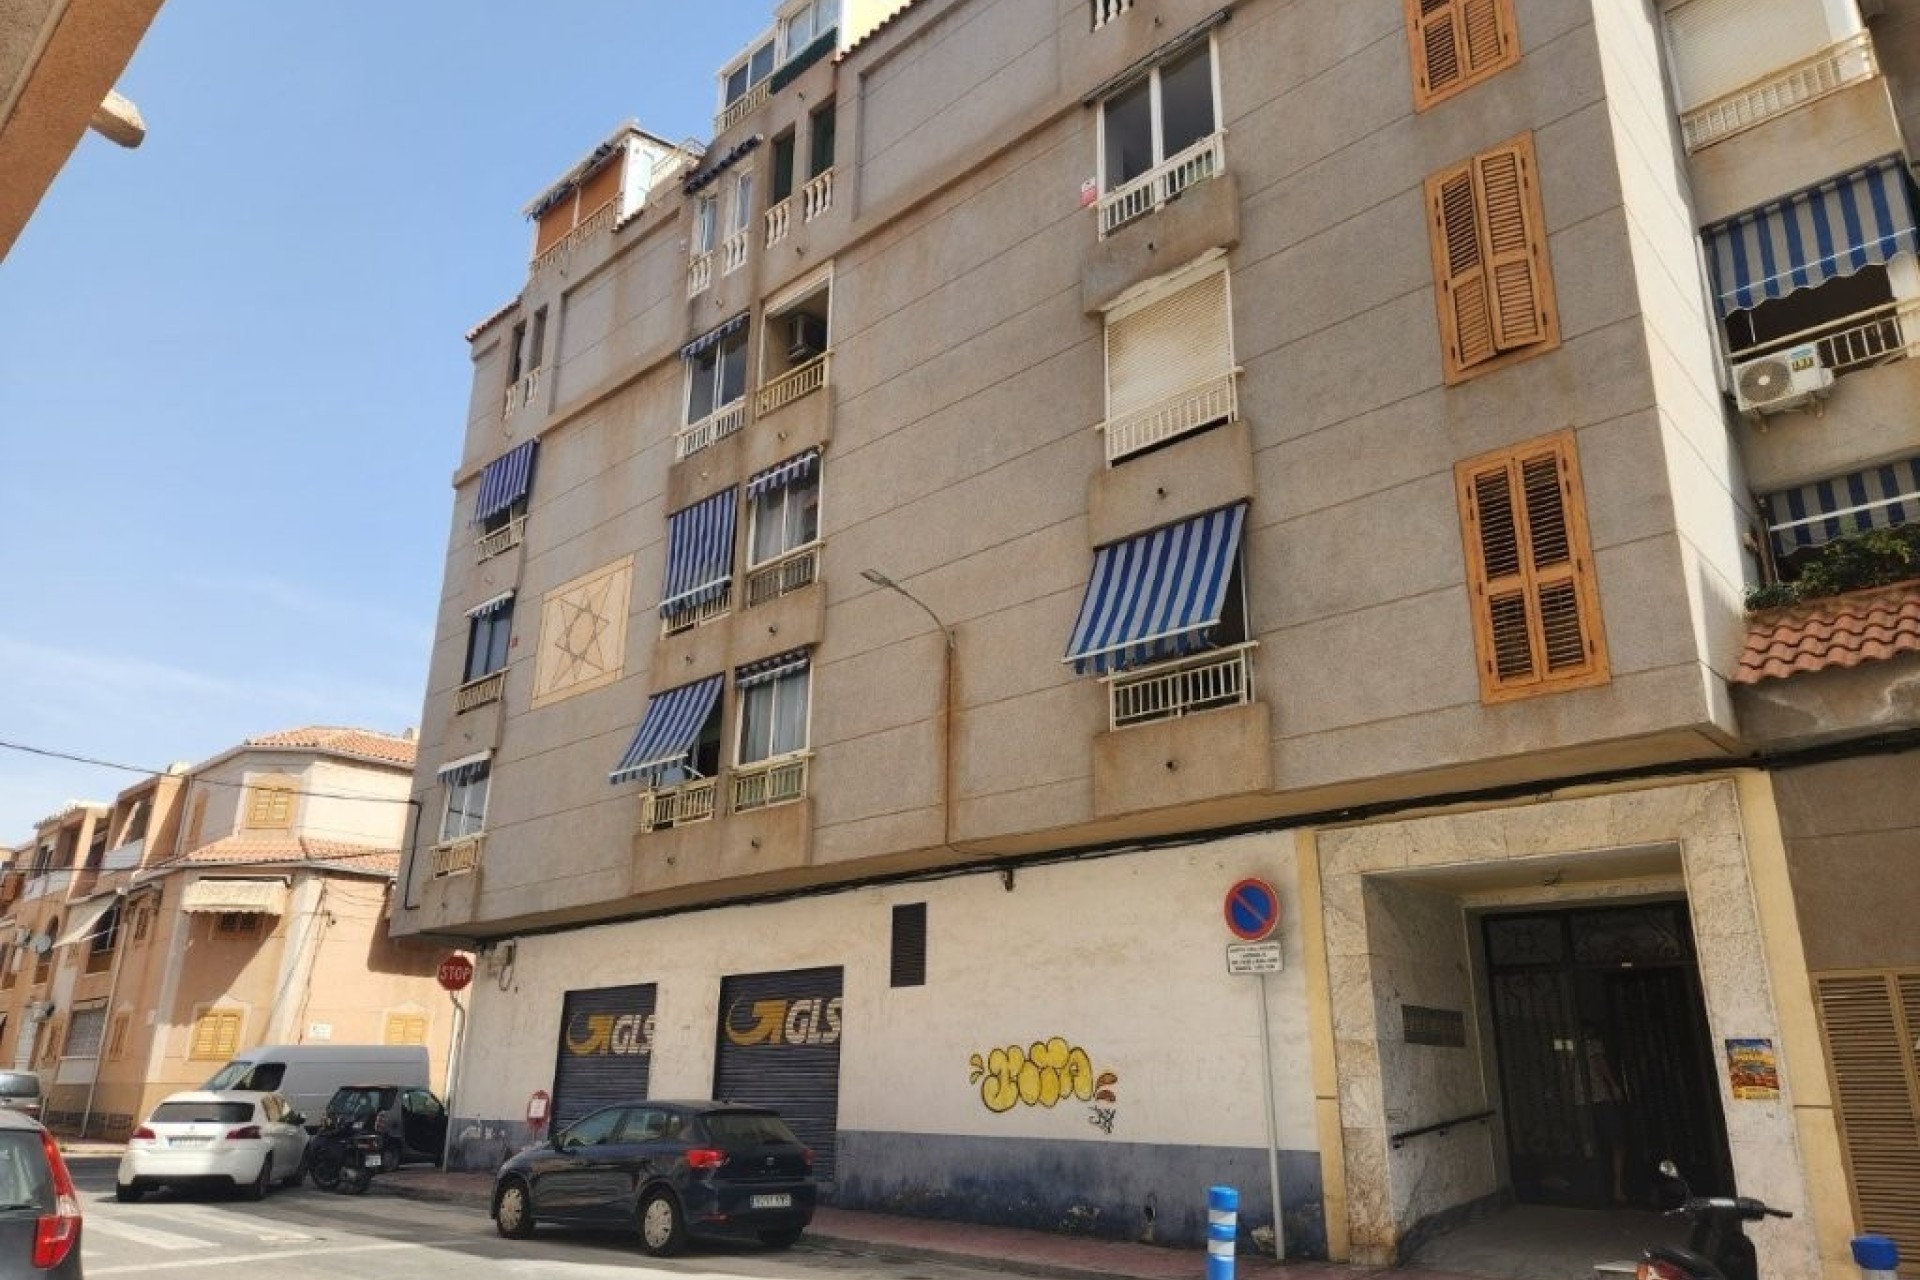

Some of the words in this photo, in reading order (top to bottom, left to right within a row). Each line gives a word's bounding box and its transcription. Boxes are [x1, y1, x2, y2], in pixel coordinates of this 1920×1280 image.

[440, 965, 472, 981] STOP
[612, 1014, 656, 1054] GLS
[784, 998, 843, 1044] GLS
